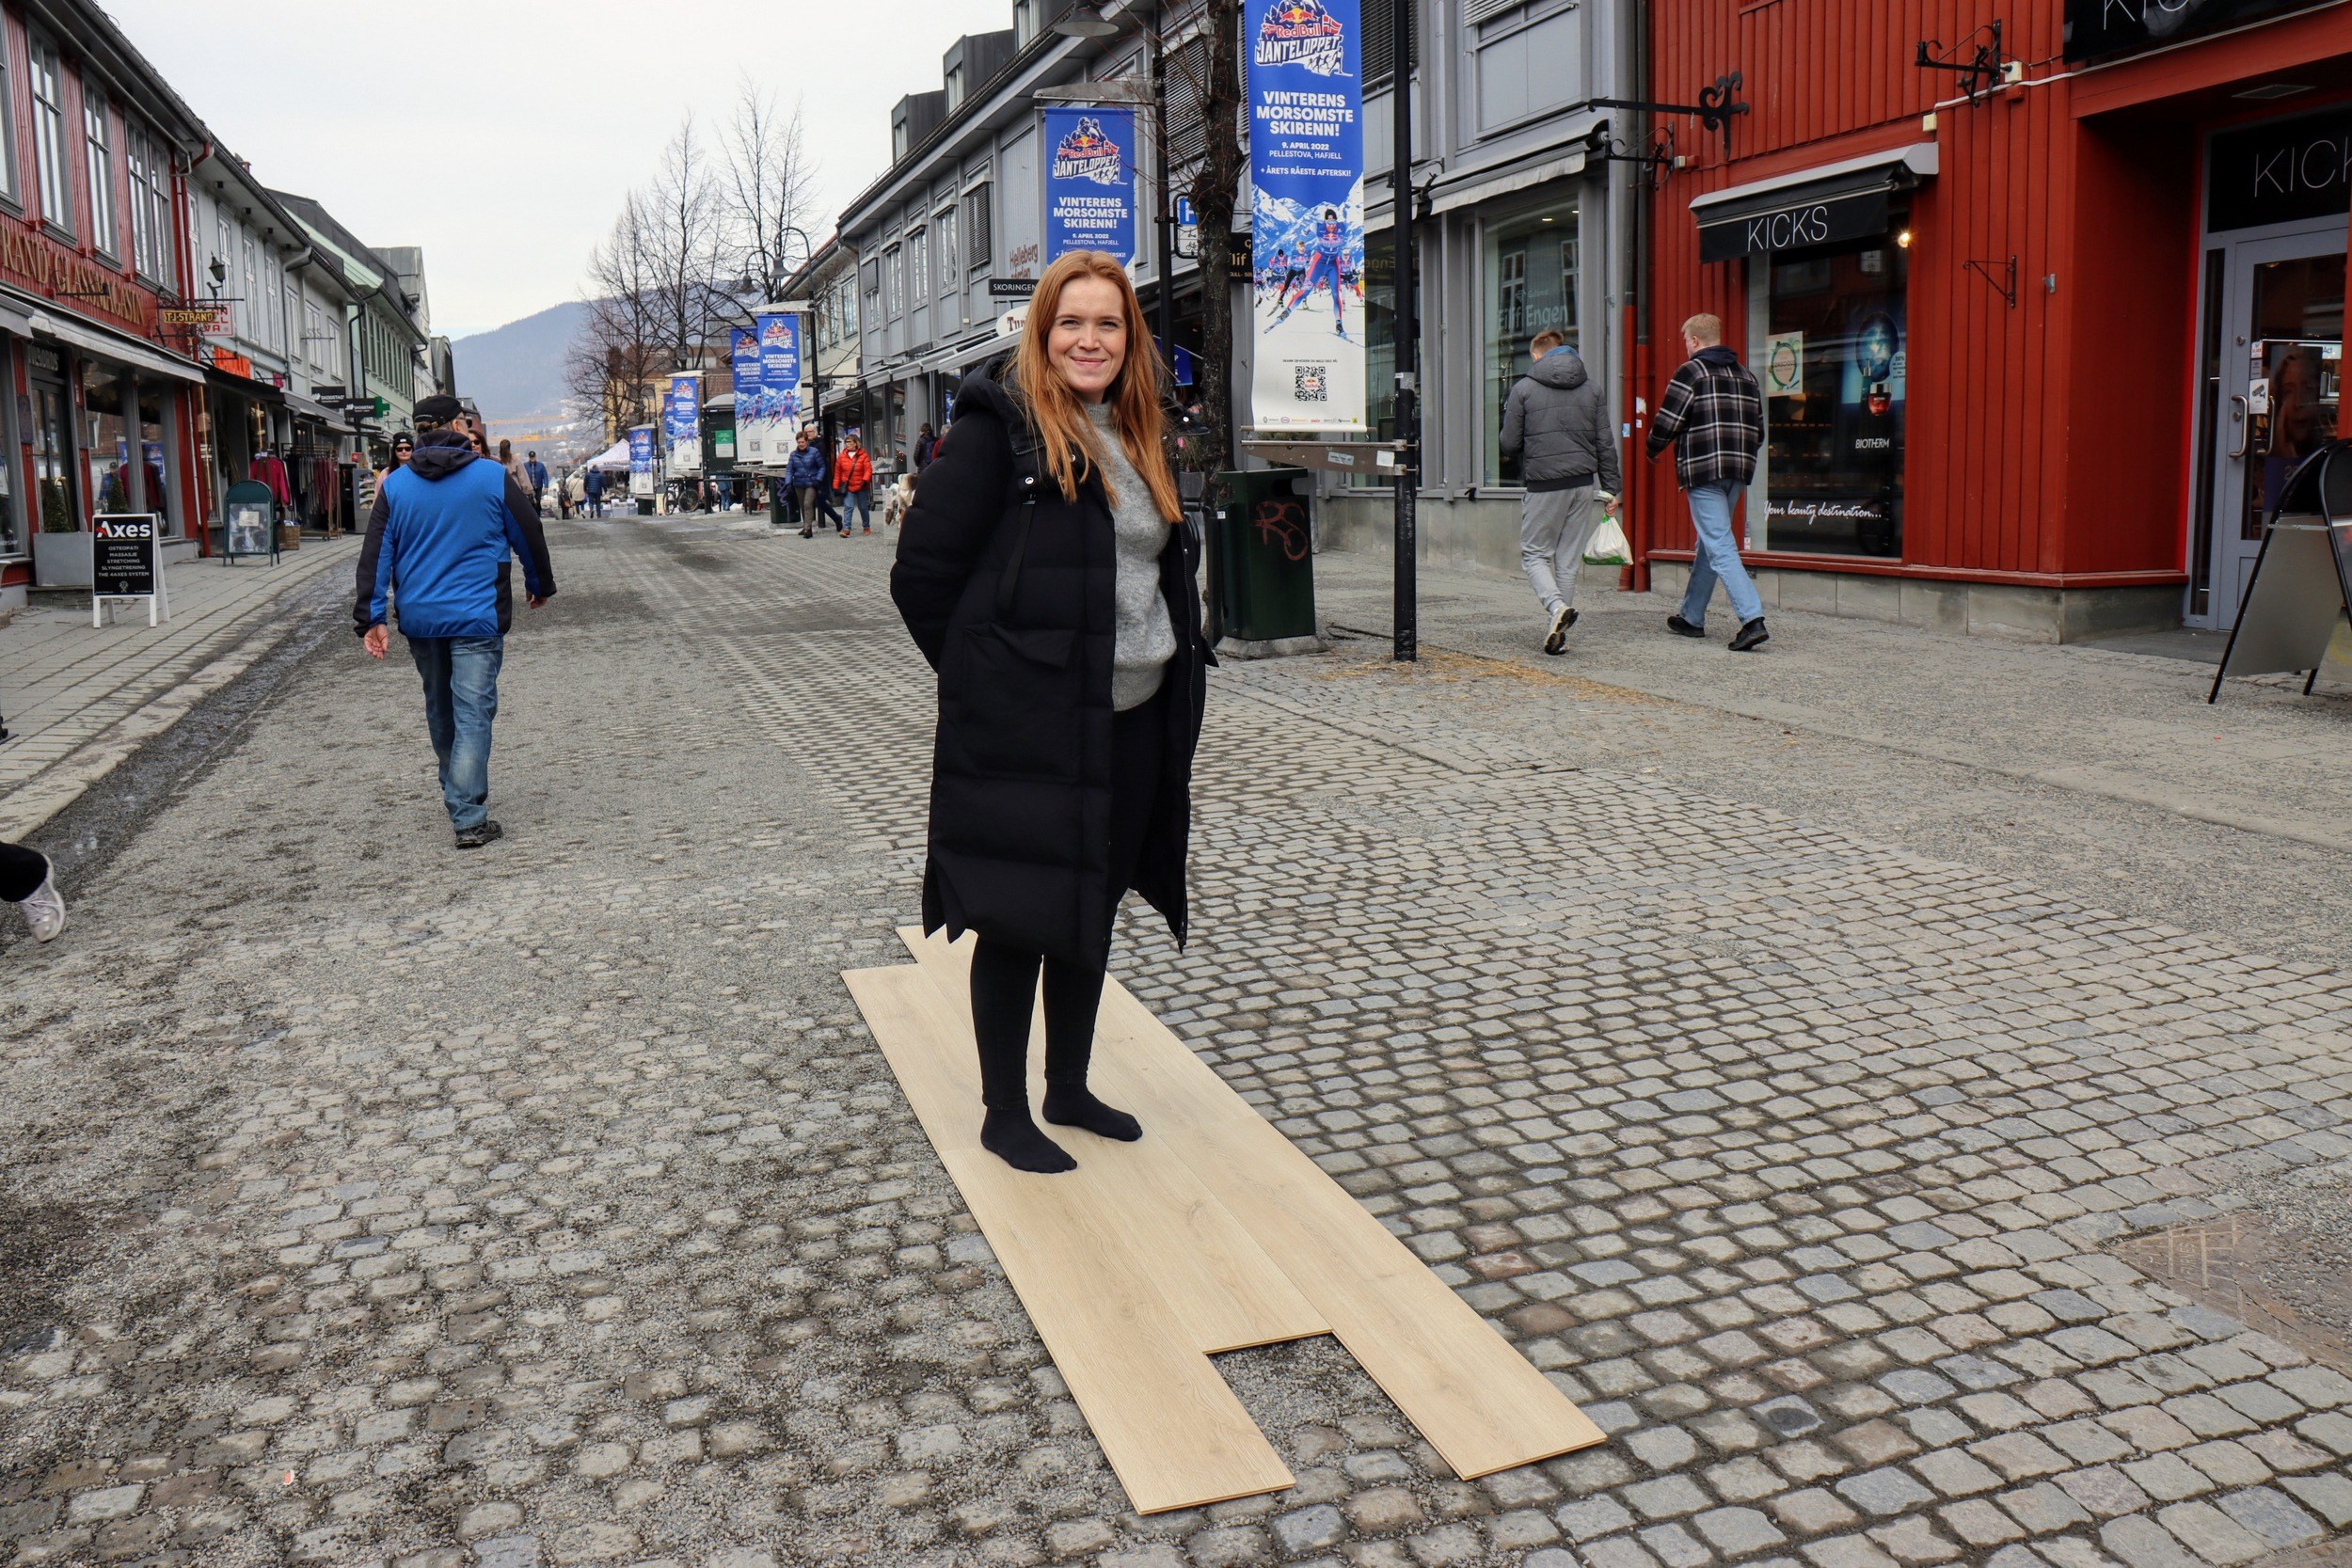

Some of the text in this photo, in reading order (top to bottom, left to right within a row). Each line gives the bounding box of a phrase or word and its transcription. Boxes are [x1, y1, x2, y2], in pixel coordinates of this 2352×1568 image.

[1277, 23, 1322, 38] Red Bull
[1255, 35, 1342, 64] JANTELOPPET
[1263, 90, 1346, 108] VINTERENS
[1256, 105, 1354, 123] MORSOMSTE
[1269, 120, 1340, 137] SKIRENN!
[1269, 150, 1343, 160] PELLESTOVA, HAFJELL
[1054, 155, 1119, 178] JANTELOPPET
[1266, 165, 1289, 175] ÅRETS
[1290, 166, 1316, 176] RÅESTE
[1317, 168, 1352, 177] AFTERSKI!
[1058, 197, 1122, 208] VINTERENS
[1053, 207, 1128, 218] MORSOMSTE
[1063, 218, 1118, 229] SKIRENN!
[1747, 205, 1828, 252] KICKS
[993, 283, 1037, 292] SKORINGEN
[1526, 304, 1567, 331] Engen
[1854, 437, 1890, 450] BIOTHERM
[1763, 499, 1786, 521] Your
[1787, 499, 1818, 526] beauty
[95, 520, 151, 538] Axes
